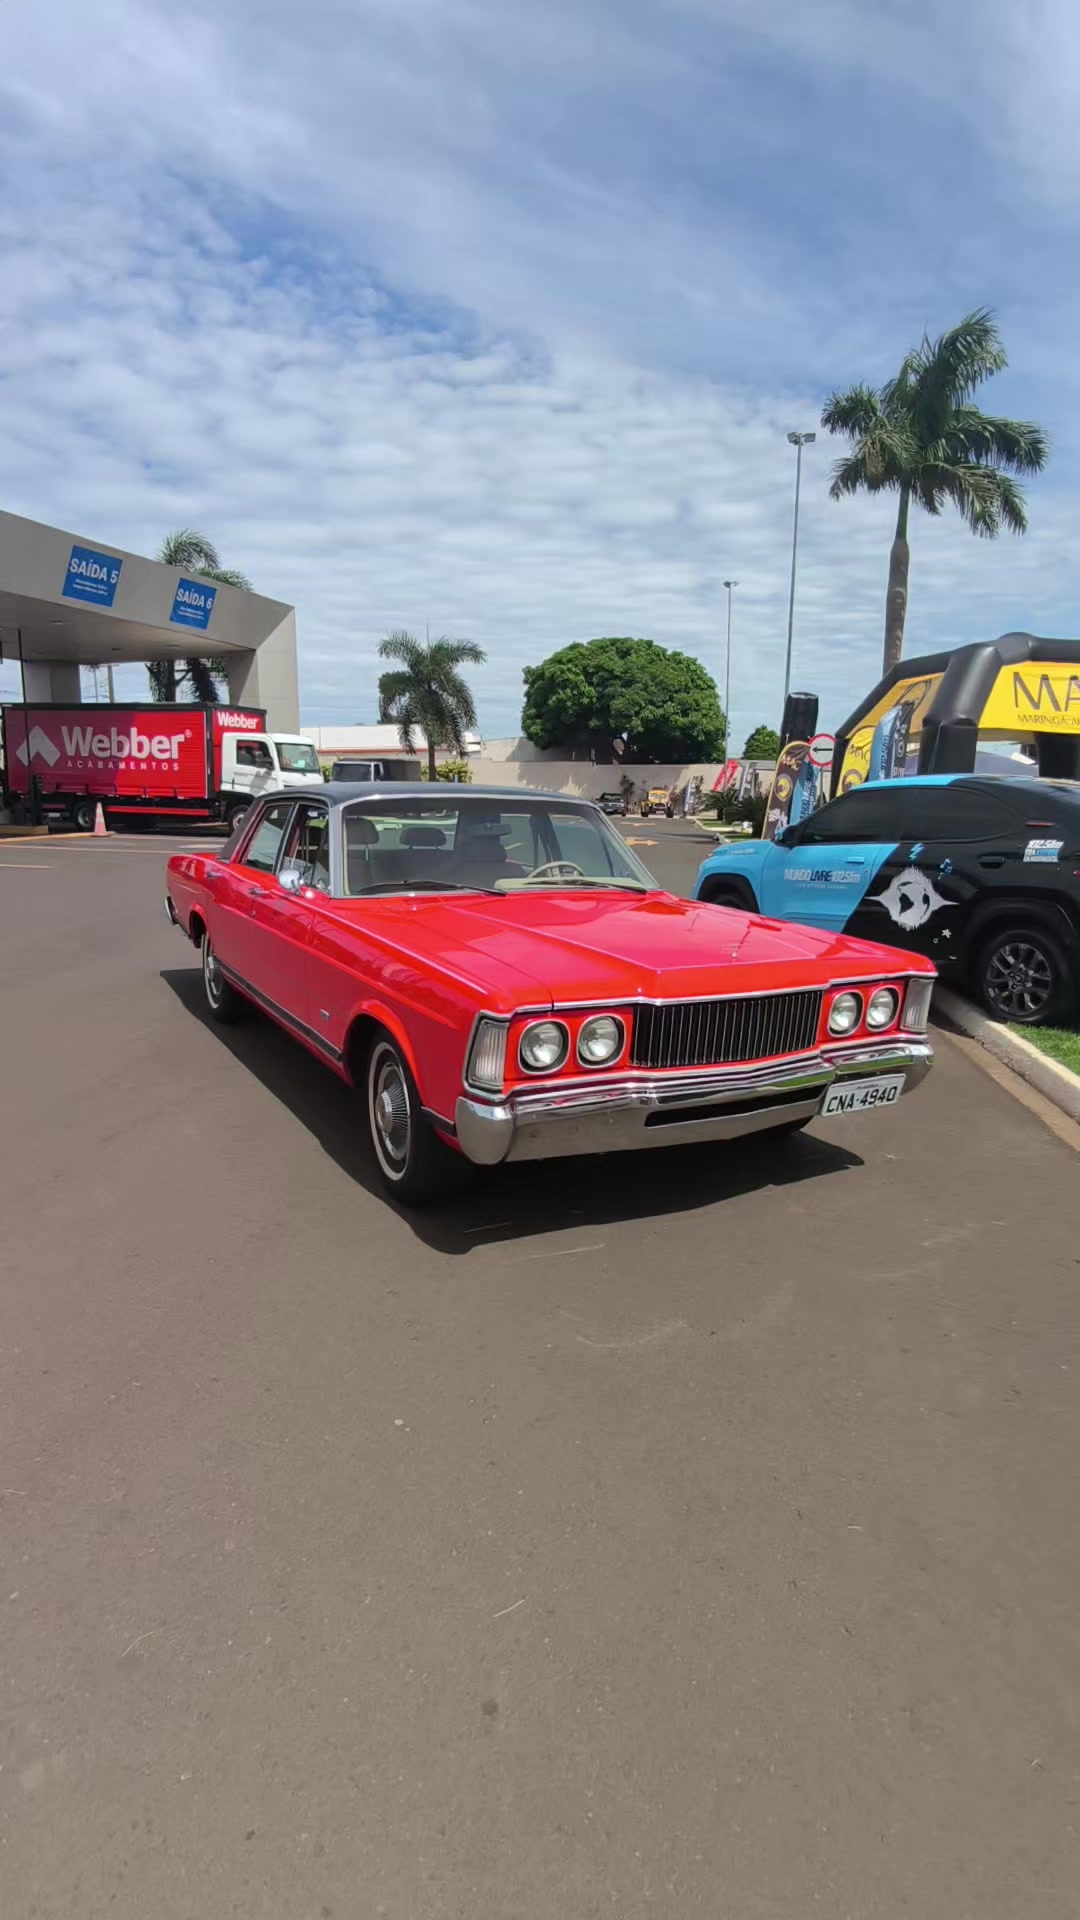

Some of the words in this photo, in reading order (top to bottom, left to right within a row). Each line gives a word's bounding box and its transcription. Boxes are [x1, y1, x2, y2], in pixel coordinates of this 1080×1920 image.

[69, 558, 108, 582] SAÍDA
[110, 570, 120, 584] 5
[175, 588, 205, 608] SAÍDA
[206, 597, 213, 610] 6
[217, 711, 258, 730] Webber
[66, 759, 180, 771] ACABAMENTOS
